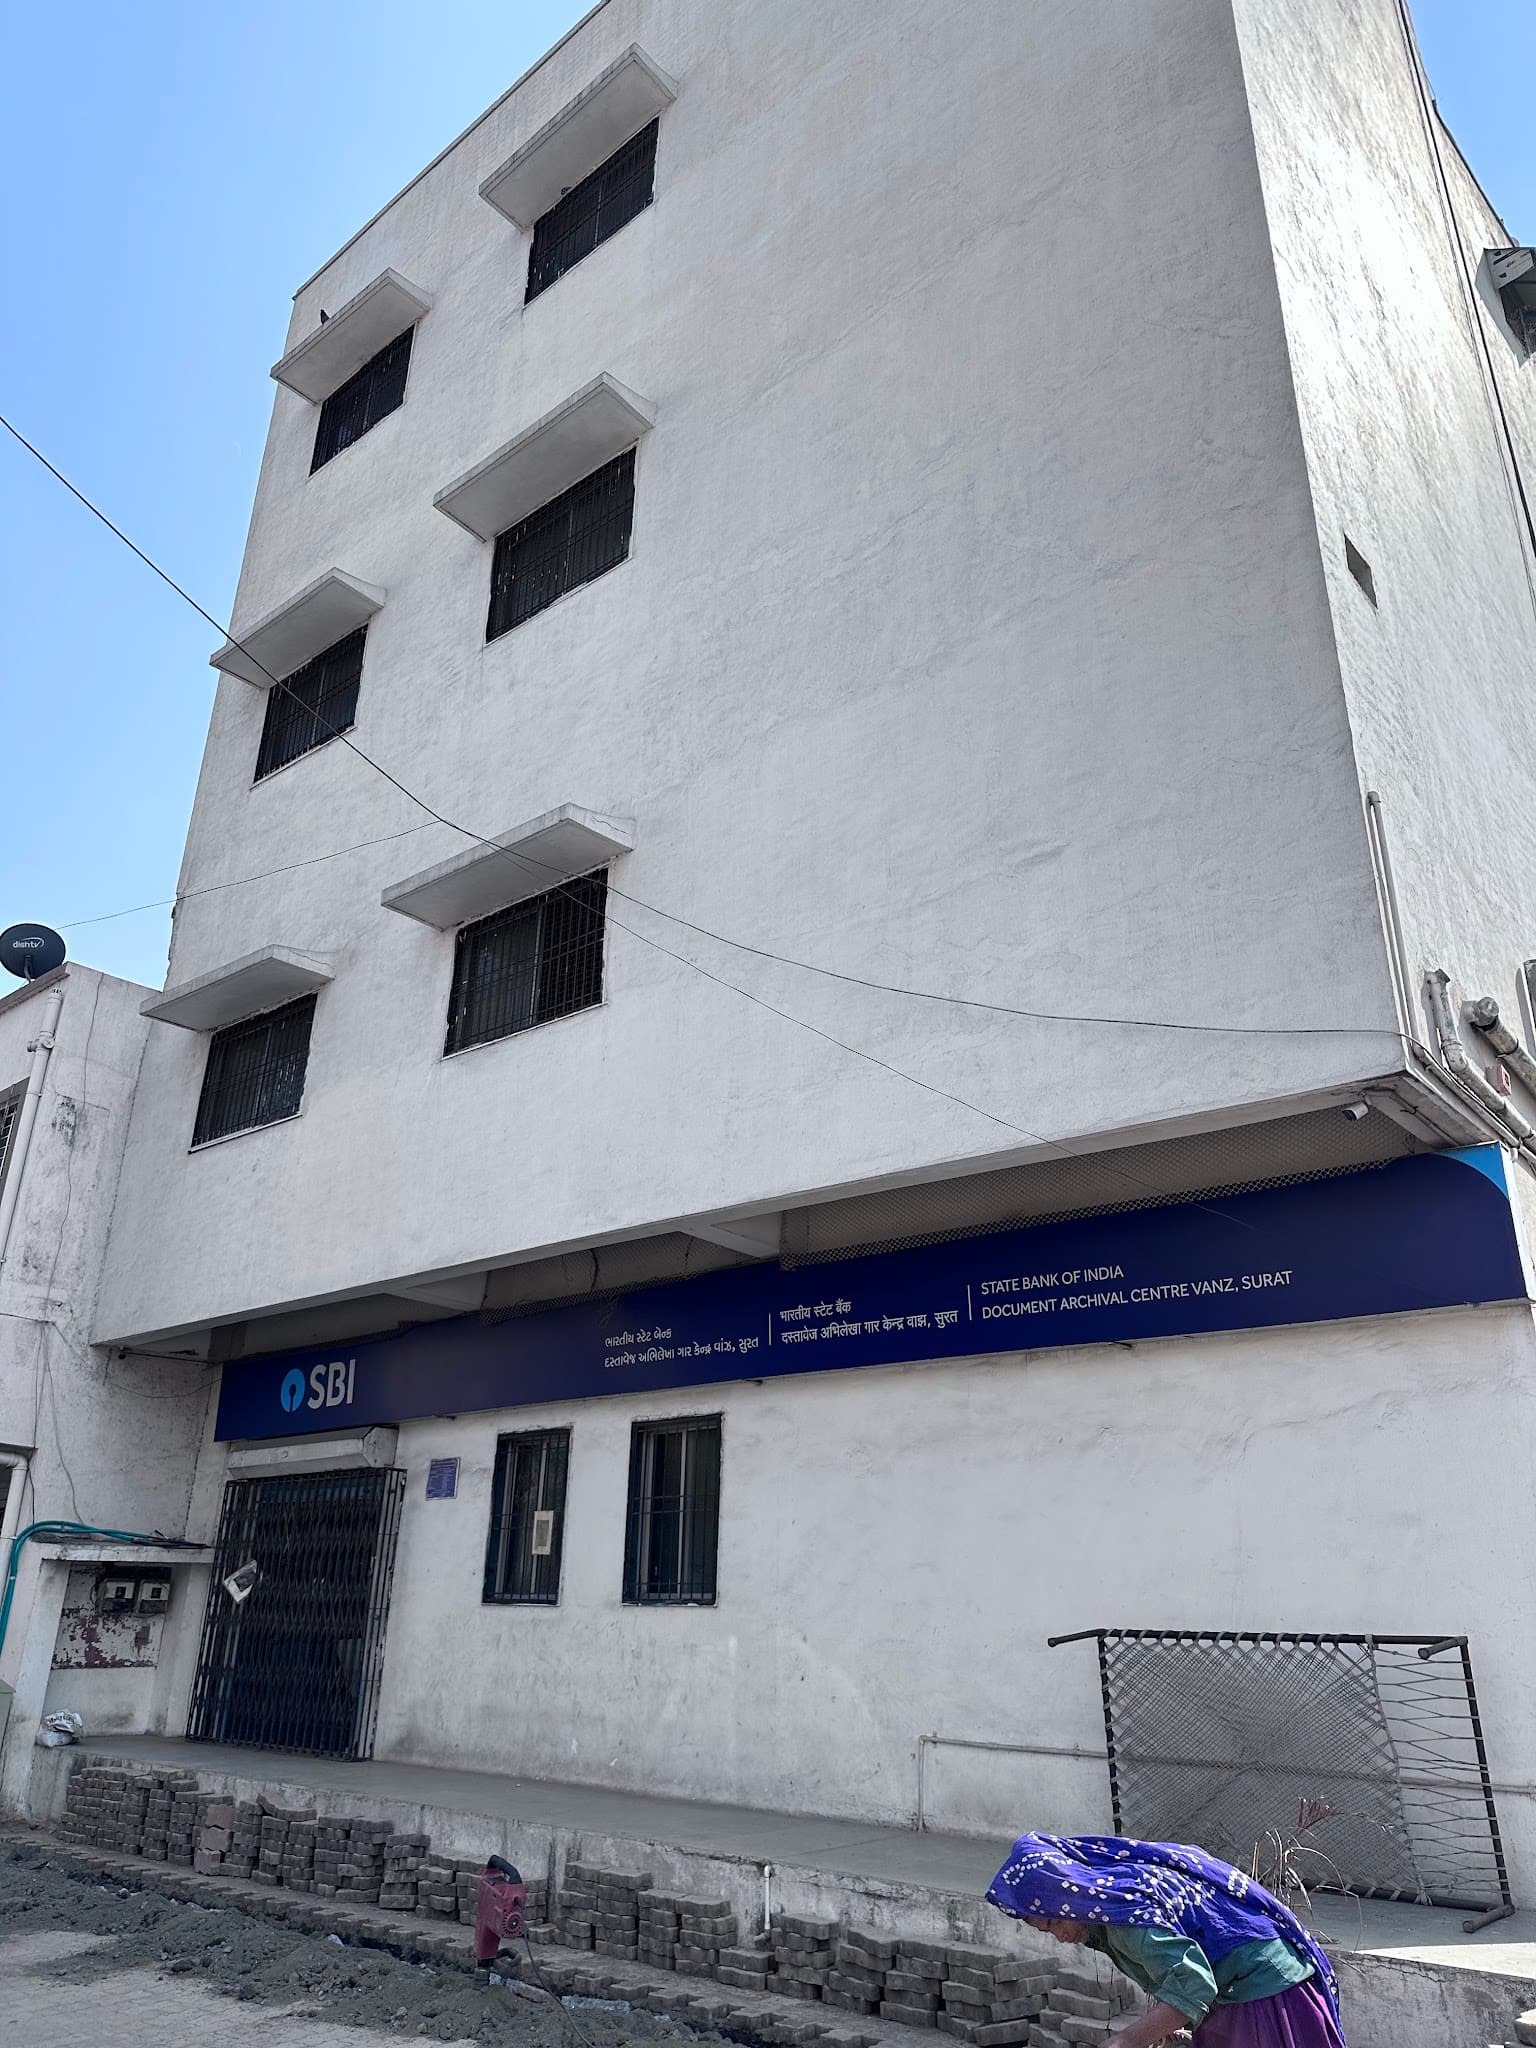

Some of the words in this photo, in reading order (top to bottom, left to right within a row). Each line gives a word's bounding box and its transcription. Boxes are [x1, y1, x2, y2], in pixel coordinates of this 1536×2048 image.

[982, 1278, 1020, 1295] STATE
[1022, 1273, 1060, 1290] BANK
[1061, 1270, 1081, 1285] OF
[1084, 1265, 1124, 1282] INDIA
[982, 1298, 1058, 1319] DOCUMENT
[1060, 1290, 1129, 1311] ARCHIVAL
[1130, 1283, 1190, 1303] CENTRE
[1190, 1277, 1239, 1297] VANZ,
[1241, 1270, 1293, 1290] SURAT
[779, 1304, 811, 1322] भारतीय
[814, 1301, 833, 1317] स्टेट
[835, 1298, 852, 1314] बैंक
[604, 1331, 634, 1348] ભારતીય
[636, 1328, 652, 1343] સ્ટેટ
[653, 1326, 672, 1341] બેન્ક
[781, 1325, 818, 1344] दस्तावेज
[820, 1320, 861, 1339] अभिलेखा
[864, 1320, 880, 1334] गार
[882, 1314, 904, 1331] केन्द्र
[934, 1310, 958, 1329] सुरत
[604, 1352, 637, 1368] દસ્તાવેજ
[638, 1346, 675, 1363] અભિલેખા
[677, 1345, 692, 1359] ગાર
[738, 1336, 759, 1354] સુરત
[307, 1359, 356, 1409] SBI
